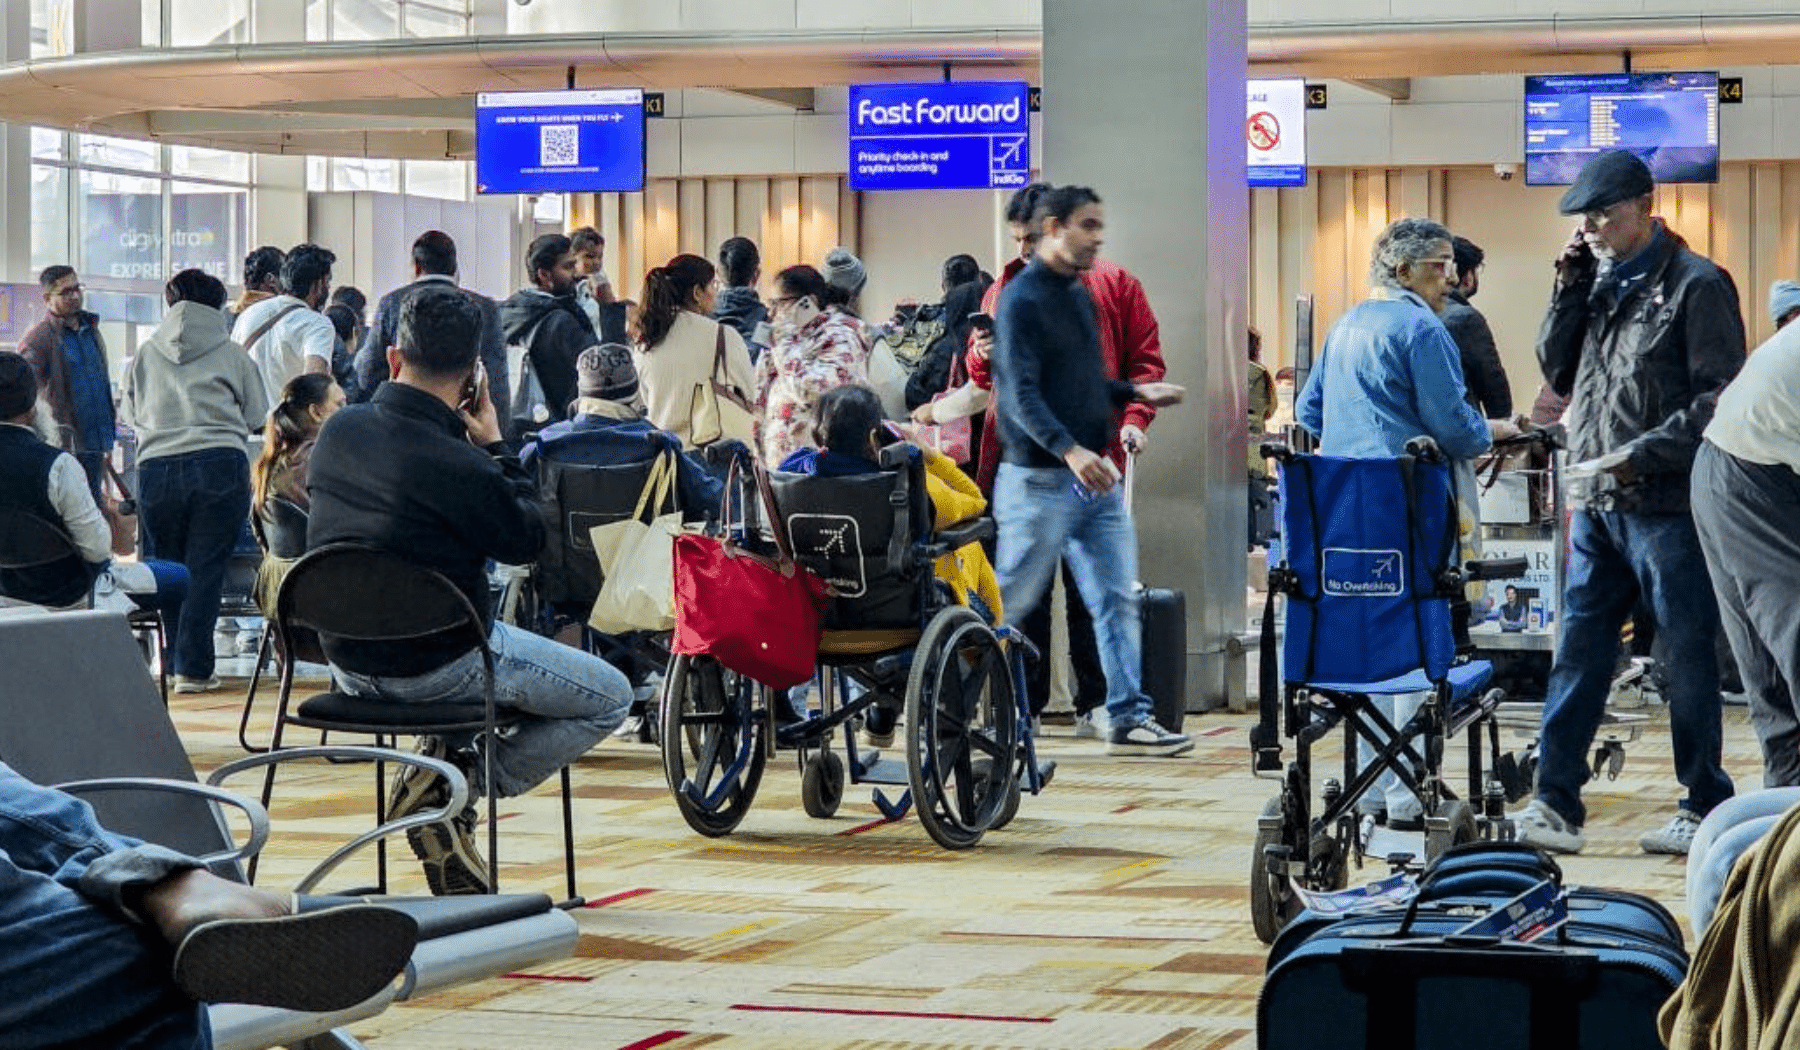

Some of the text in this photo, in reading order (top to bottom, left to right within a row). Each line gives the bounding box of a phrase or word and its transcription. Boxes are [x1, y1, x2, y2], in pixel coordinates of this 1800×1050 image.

[1720, 83, 1741, 99] K4
[646, 98, 661, 113] K1
[858, 150, 949, 164] Priority check-in and
[858, 162, 938, 175] anytime boarding
[993, 174, 1025, 185] IndiGo
[1328, 579, 1396, 592] No Overtaking
